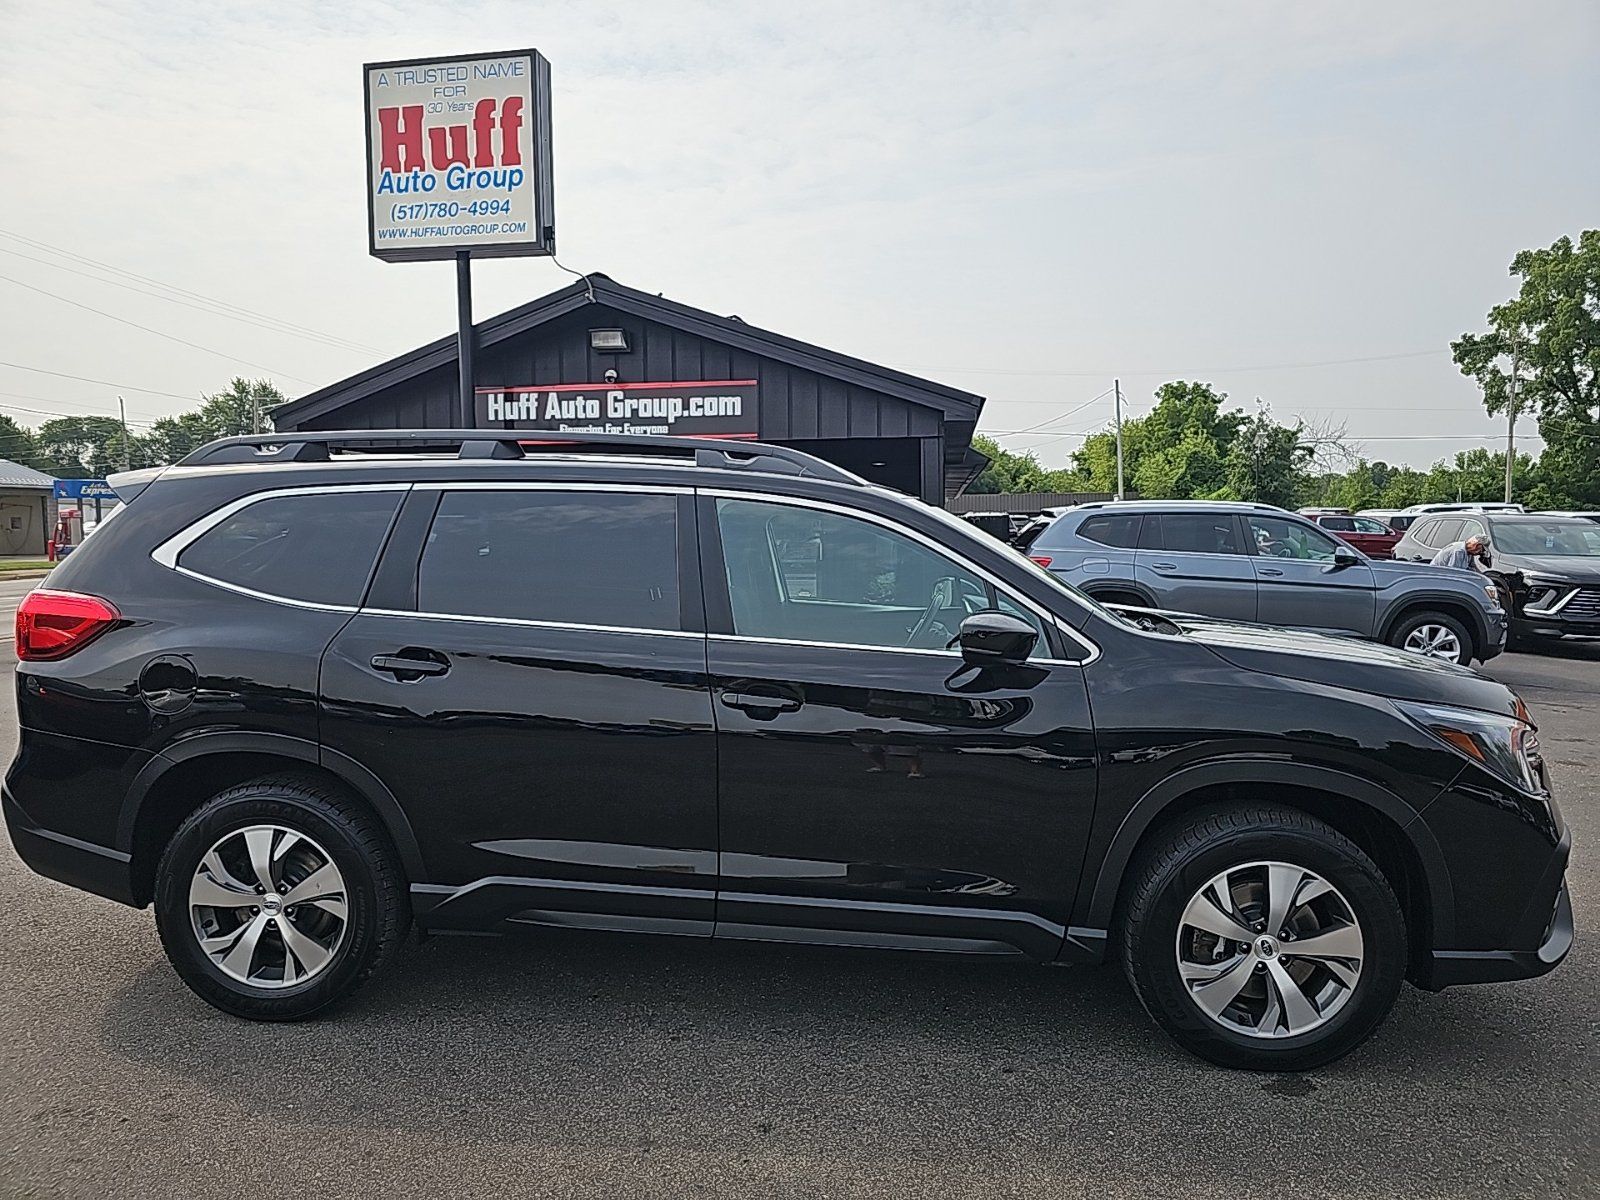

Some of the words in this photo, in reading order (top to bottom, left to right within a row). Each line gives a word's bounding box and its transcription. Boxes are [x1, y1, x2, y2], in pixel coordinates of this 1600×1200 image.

[378, 73, 389, 87] A
[394, 66, 468, 86] TRUSTED
[473, 61, 523, 79] NAME
[433, 85, 466, 98] FOR
[427, 103, 443, 113] 30
[447, 101, 474, 112] Years
[378, 96, 523, 173] Huff
[377, 170, 436, 194] Auto
[446, 165, 524, 192] Group
[391, 199, 511, 221] (517)780-4994
[378, 222, 526, 239] WWW.HUFFAUTOGROUP.COM
[487, 393, 537, 421] Huff
[544, 392, 600, 420] Auto
[607, 391, 742, 423] Group.com
